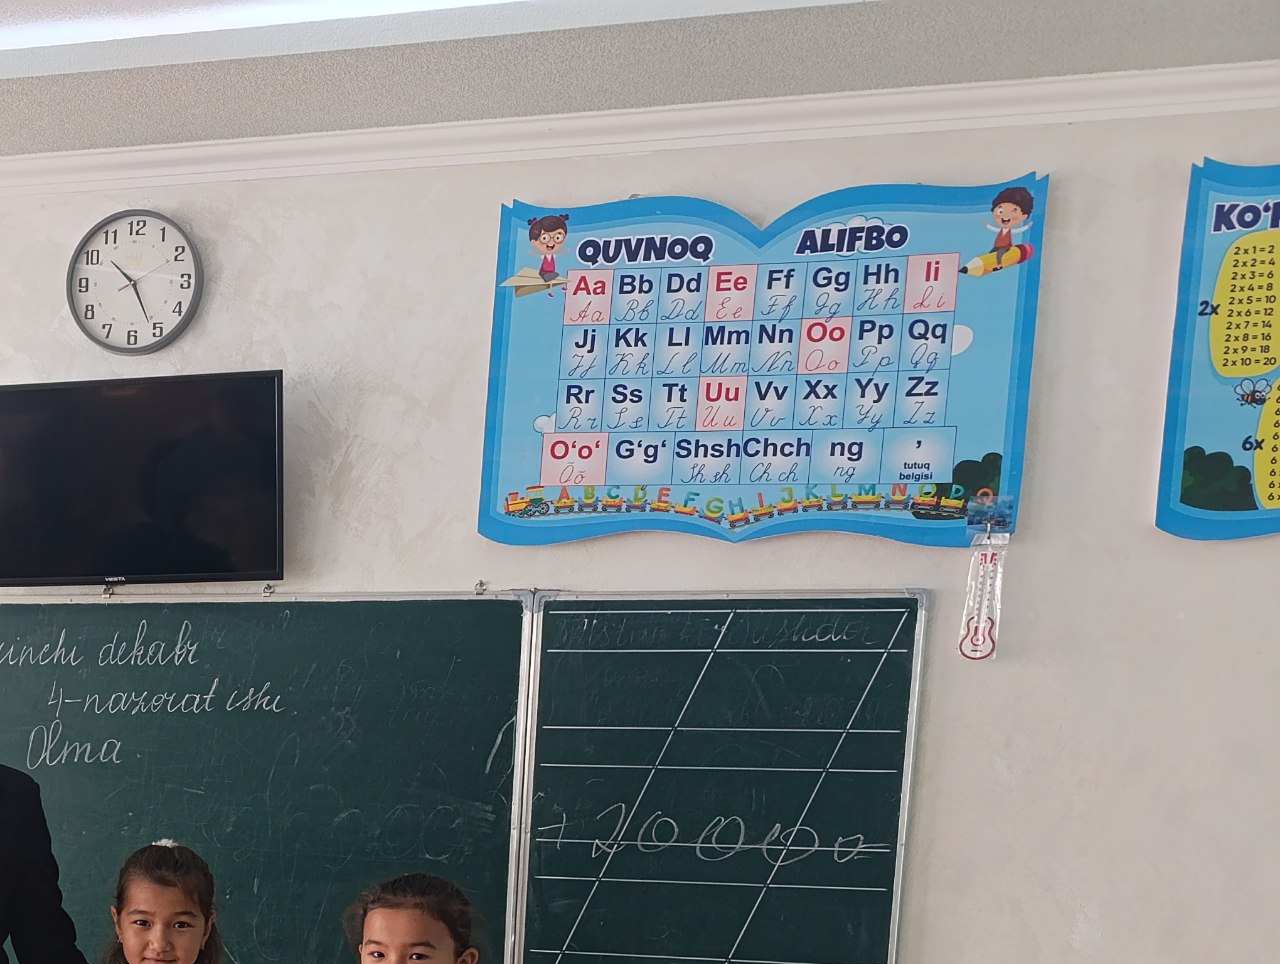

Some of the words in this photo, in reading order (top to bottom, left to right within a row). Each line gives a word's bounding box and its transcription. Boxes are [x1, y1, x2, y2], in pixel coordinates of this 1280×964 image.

[128, 220, 147, 236] 12
[160, 227, 165, 242] 1
[103, 229, 118, 245] 11
[578, 236, 713, 265] QUVNOQ
[795, 224, 909, 254] ALIFBO
[84, 250, 100, 265] 10
[174, 246, 185, 262] 2
[1234, 246, 1240, 255] 2
[1252, 246, 1256, 254] 1
[1268, 245, 1274, 253] 2
[1233, 259, 1239, 267] 2
[1250, 258, 1257, 267] 2
[1268, 258, 1275, 266] 4
[180, 274, 191, 289] 3
[572, 276, 606, 296] Aa
[618, 274, 653, 294] Bb
[666, 272, 702, 293] Dd
[716, 272, 748, 291] Ee
[767, 269, 795, 289] Ff
[812, 267, 850, 292] Gg
[863, 262, 899, 285] Hh
[925, 260, 940, 282] Ii
[1231, 272, 1237, 280] 2
[1249, 271, 1256, 279] 3
[78, 277, 89, 293] 9
[1230, 284, 1237, 292] 2
[1266, 283, 1273, 291] 8
[1229, 297, 1235, 305] 2
[1246, 296, 1253, 304] 5
[1265, 295, 1276, 304] 10
[84, 304, 94, 320] 8
[172, 301, 183, 316] 4
[1198, 300, 1221, 316] 2x
[1227, 309, 1234, 317] 2
[1245, 309, 1252, 317] 6
[1264, 308, 1274, 316] 12
[102, 324, 112, 339] 7
[127, 330, 138, 345] 6
[153, 322, 164, 338] 5
[575, 329, 596, 353] Jj
[614, 328, 648, 348] Kk
[667, 327, 690, 347] Ll
[704, 326, 749, 346] Mm
[758, 324, 793, 344] Nn
[806, 322, 845, 342] Oo
[858, 320, 894, 345] Pp
[908, 319, 947, 344] Qq
[1222, 358, 1229, 366] 2
[1240, 358, 1251, 366] 10
[1263, 357, 1276, 365] 20
[566, 385, 595, 404] Rr
[611, 384, 643, 404] Ss
[662, 383, 688, 402] Tt
[705, 382, 739, 402] Uu
[754, 381, 788, 400] Vv
[803, 379, 838, 400] Xx
[855, 378, 889, 403] Yy
[905, 376, 939, 397] Zz
[675, 438, 740, 459] Shsh
[742, 437, 810, 458] Chch
[829, 441, 864, 461] ng
[1242, 435, 1265, 451] 6x
[903, 462, 930, 471] tutuq
[899, 472, 933, 482] belgisi
[27, 720, 122, 769] Olma
